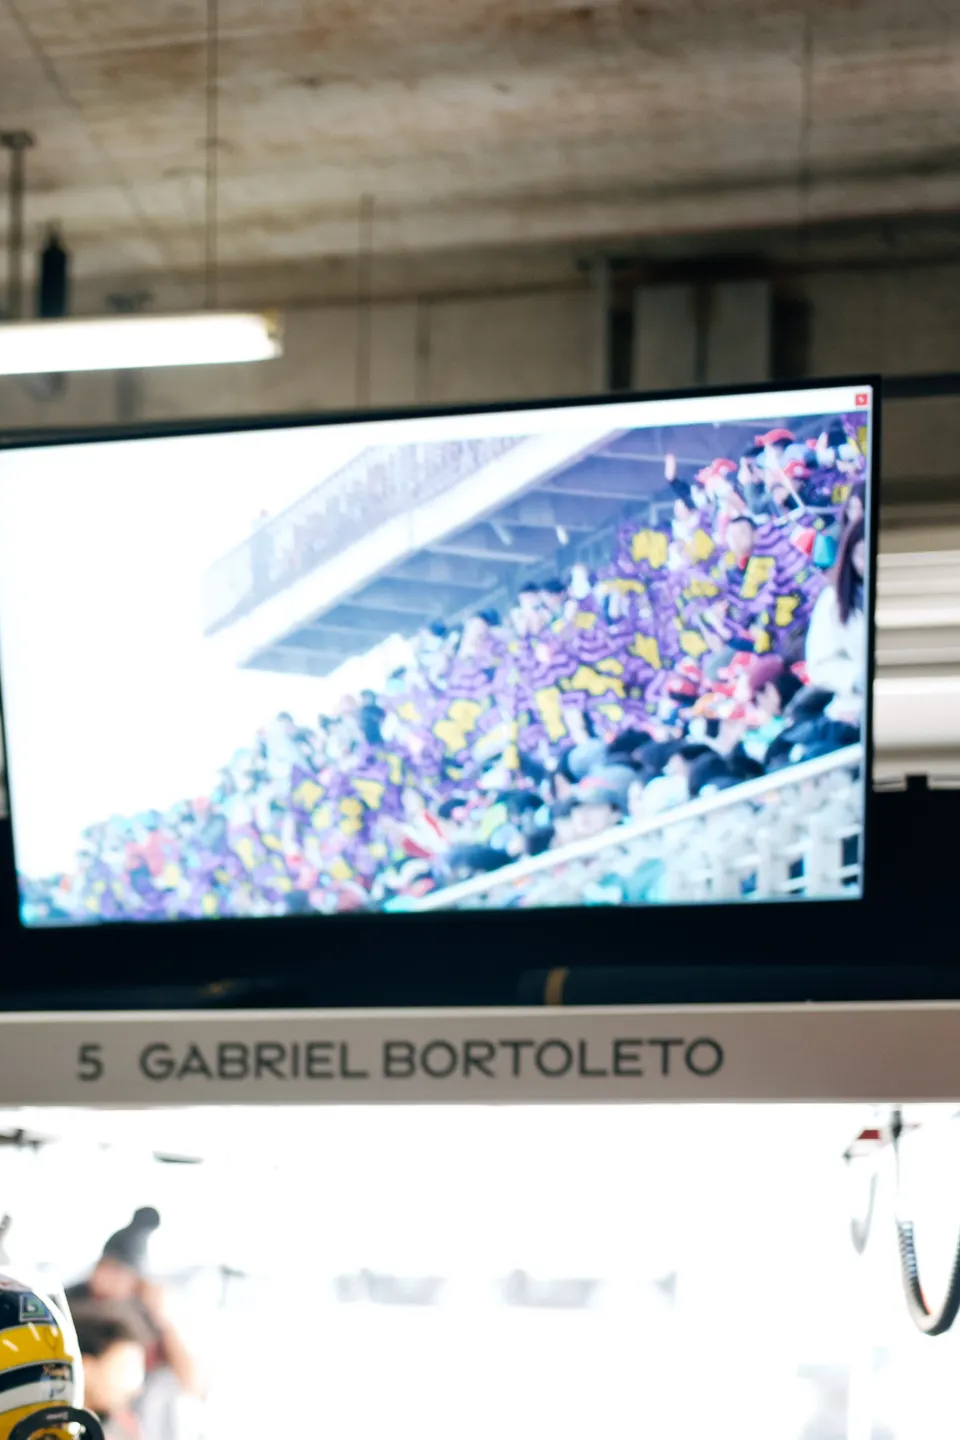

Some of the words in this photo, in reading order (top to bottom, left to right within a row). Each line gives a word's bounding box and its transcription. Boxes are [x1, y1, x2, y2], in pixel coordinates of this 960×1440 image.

[76, 1042, 104, 1082] 5
[139, 1041, 368, 1080] GABRIEL
[383, 1037, 724, 1078] BORTOLETO
